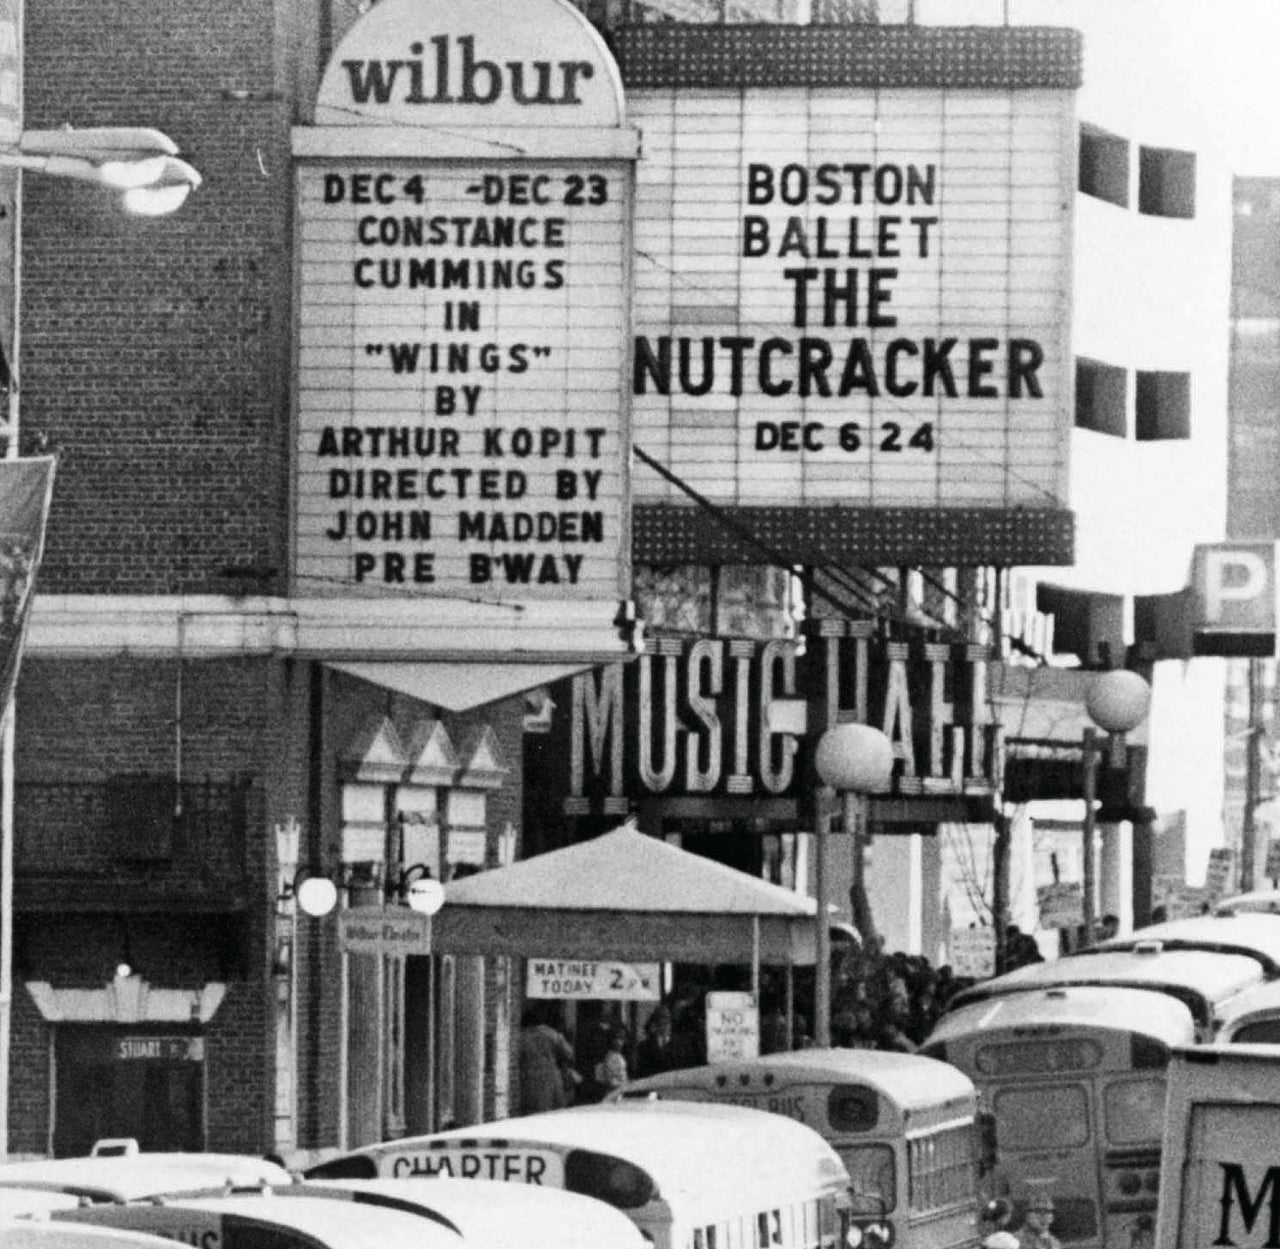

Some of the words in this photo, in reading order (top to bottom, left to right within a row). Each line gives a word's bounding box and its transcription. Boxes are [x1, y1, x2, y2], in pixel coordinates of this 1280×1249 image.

[343, 36, 592, 104] wilbur
[563, 175, 607, 205] 23
[749, 165, 933, 205] BOSTON
[358, 216, 565, 247] CONSTANCE
[743, 217, 936, 258] BALLET
[354, 258, 563, 289] CUMMINGS
[785, 268, 897, 329] THE
[445, 302, 479, 331] IN
[366, 344, 550, 373] "WINGS"
[632, 336, 1042, 398] NUTCRACKER
[436, 386, 480, 415] BY
[316, 427, 459, 457] ARTHUR
[484, 428, 605, 458] KOPIT
[755, 422, 823, 451] DEC
[840, 423, 860, 451] 6
[880, 423, 933, 451] 24
[327, 468, 526, 500] DIRECTED
[556, 470, 601, 500] BY
[325, 510, 431, 541] JOHN
[458, 512, 603, 542] MADDEN
[351, 552, 435, 584] PRE
[562, 636, 800, 815] MUSIC
[541, 979, 593, 995] TODAY
[609, 969, 625, 990] 2
[392, 1153, 548, 1186] CHARTER
